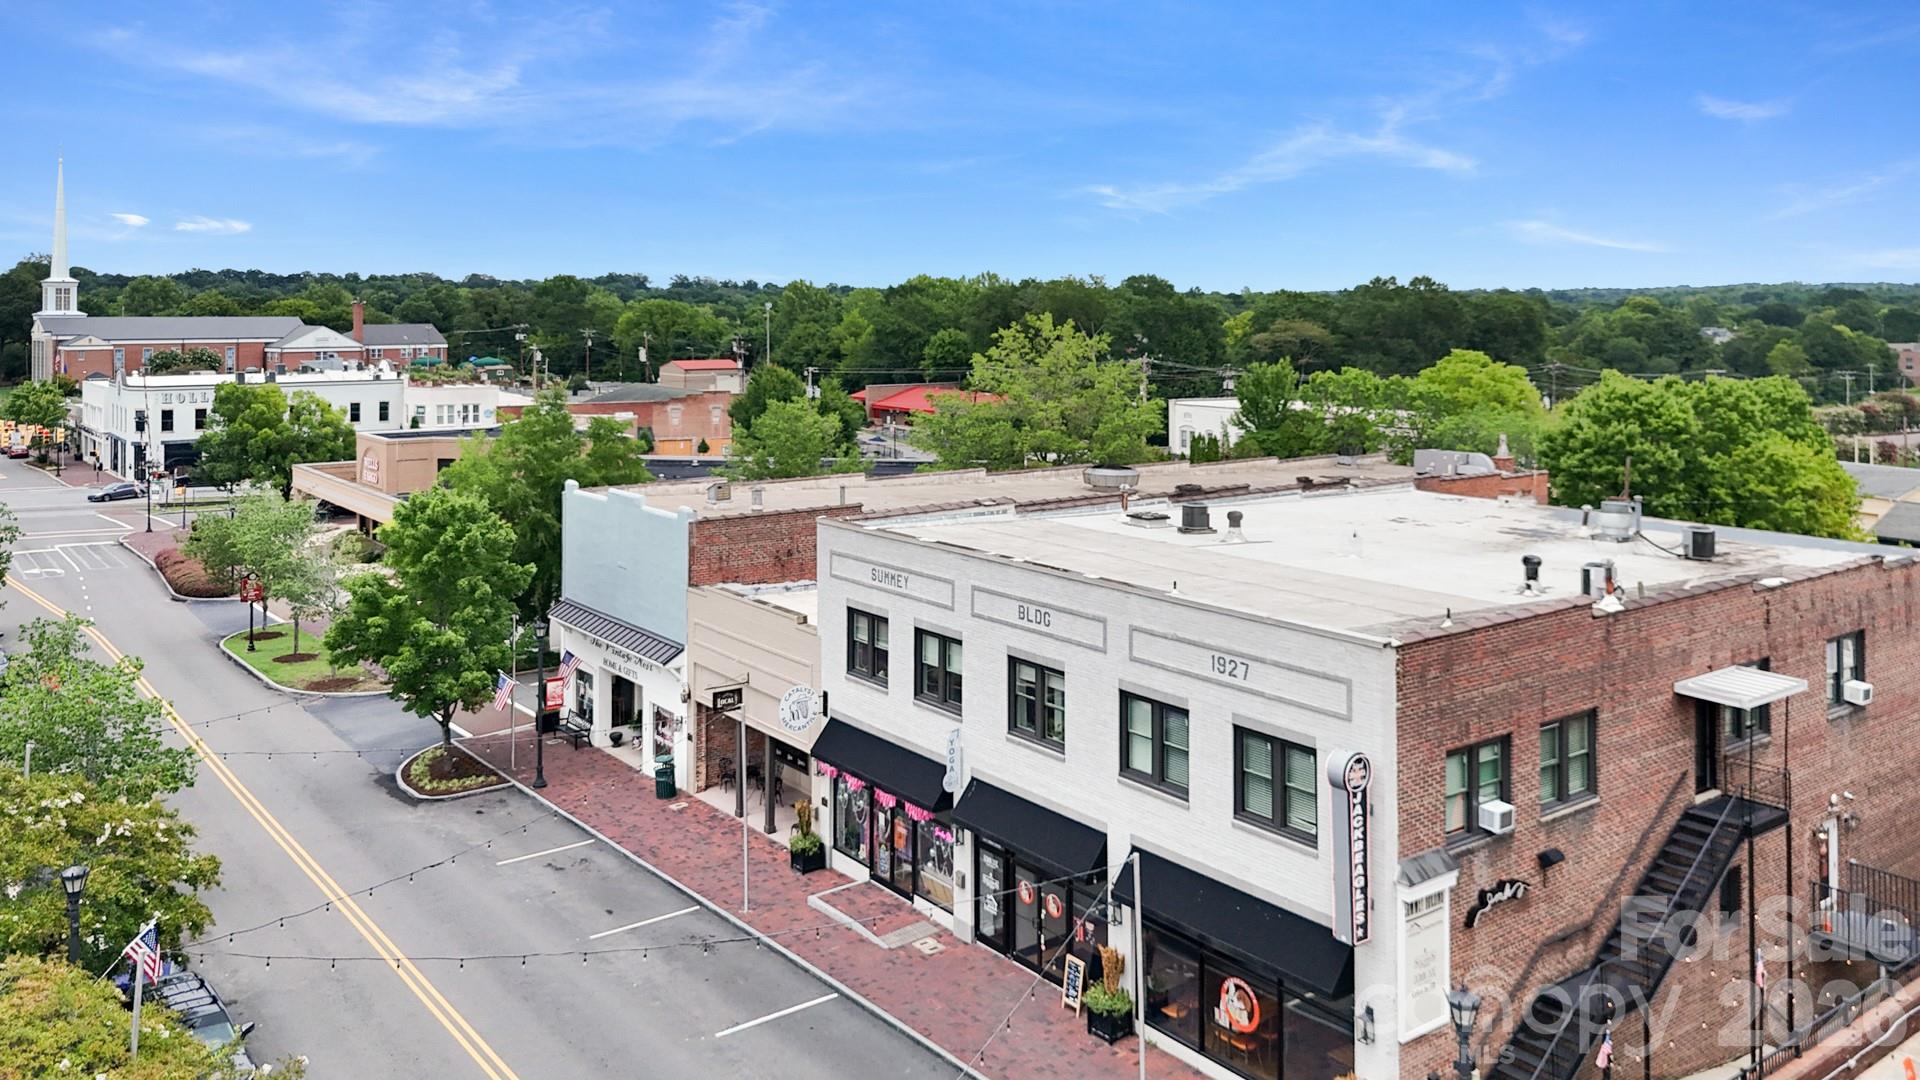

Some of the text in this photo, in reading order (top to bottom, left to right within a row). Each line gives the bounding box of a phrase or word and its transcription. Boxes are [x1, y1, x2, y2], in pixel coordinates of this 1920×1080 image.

[871, 567, 909, 590] SUMMEY
[1018, 604, 1051, 628] BLDG
[590, 637, 653, 672] The Vintage Nest
[1211, 654, 1249, 681] 1927
[784, 687, 815, 702] CATALYST
[782, 711, 818, 731] MERCANTILE
[948, 738, 956, 773] YOGA
